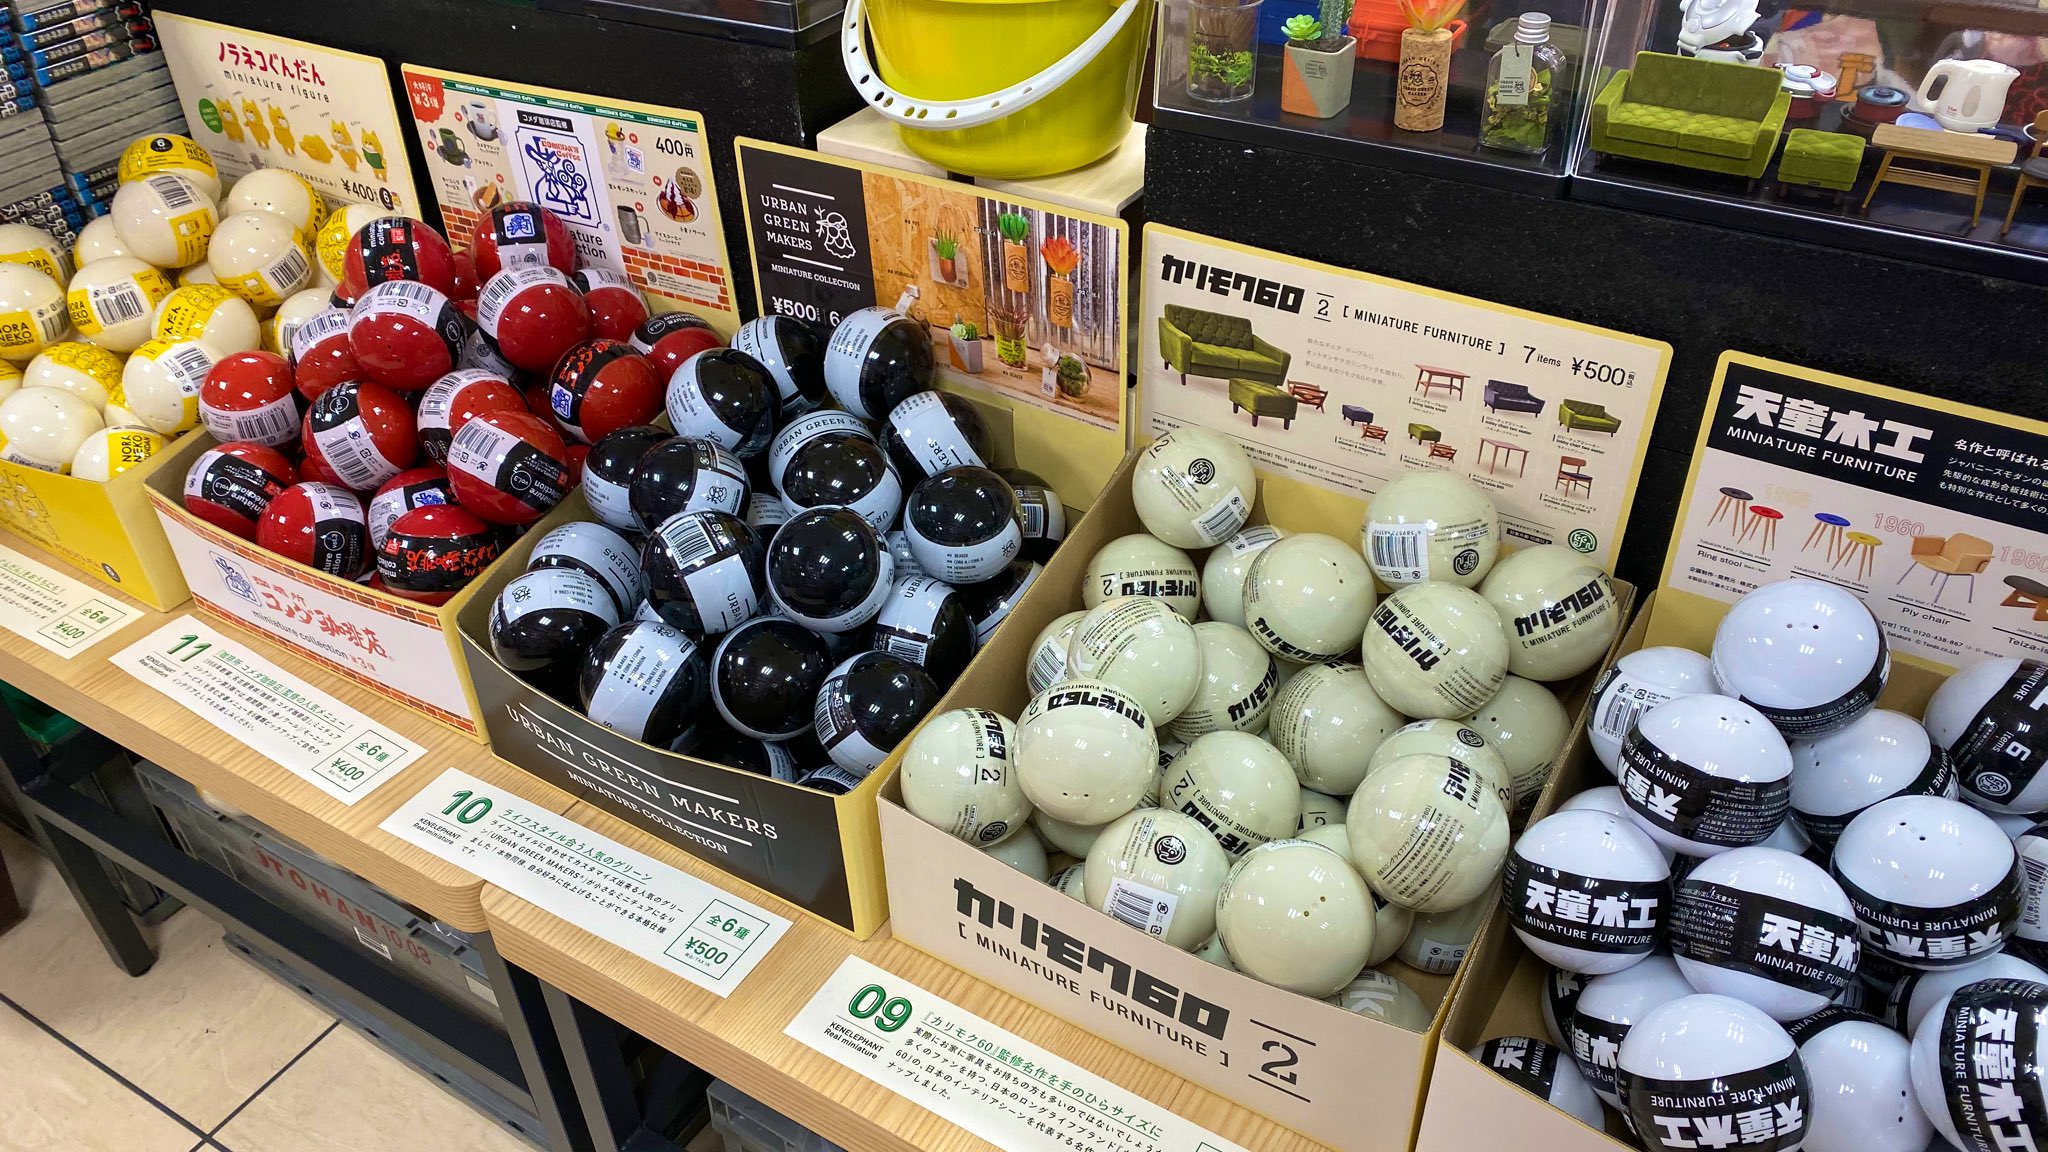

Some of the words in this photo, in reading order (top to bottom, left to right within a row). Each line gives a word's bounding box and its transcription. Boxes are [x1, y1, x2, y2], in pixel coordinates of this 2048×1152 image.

[218, 41, 325, 87] ノラネコぐんだん
[223, 69, 283, 92] miniature
[291, 84, 330, 103] figure
[556, 149, 581, 162] Coffee
[656, 137, 694, 158] 400円
[341, 177, 374, 203] ¥400
[760, 194, 808, 216] URBAN
[763, 213, 810, 234] GREEN
[766, 230, 813, 252] MAKERS
[771, 263, 813, 281] MINIATURE
[814, 273, 861, 292] COLLECTION
[1161, 253, 1306, 314] カリモク60
[1317, 298, 1330, 317] 2
[772, 295, 818, 322] ¥500
[0, 330, 32, 342] NEKO
[1354, 308, 1419, 335] MINIATURE
[1423, 325, 1493, 352] FURNITURE
[1523, 345, 1537, 364] 7
[1537, 353, 1562, 368] items
[1571, 356, 1626, 387] ¥500
[773, 429, 802, 457] URBAN
[804, 418, 846, 432] GREEN
[1732, 384, 1934, 464] 天童木工
[122, 435, 132, 463] NORA
[132, 435, 144, 463] NEKO
[1274, 453, 1284, 462] TEL
[1726, 426, 1818, 459] MINIATURE
[1822, 450, 1918, 483] FURNITURE
[1874, 512, 1925, 538] 1960
[603, 547, 638, 587] MAKERS
[1126, 568, 1163, 579] FURNITURE
[1697, 550, 1718, 562] Ring
[1719, 555, 1742, 568] stool
[80, 607, 110, 625] 全6種
[1514, 579, 1604, 637] カリモク60
[1902, 607, 1919, 618] Ply
[1922, 613, 1950, 626] chair
[55, 620, 86, 640] ¥400
[252, 610, 300, 638] miniature
[299, 631, 349, 660] collection
[1372, 603, 1441, 672] カリモク60
[1529, 625, 1572, 647] MINIATURE
[1572, 603, 1608, 629] FURNITURE
[1899, 624, 1911, 633] TEL
[1913, 628, 1964, 648] 0120-438-867
[166, 633, 212, 663] 11
[138, 659, 149, 668] Real
[147, 664, 169, 678] miniature
[144, 654, 177, 674] KENELEPHANT
[971, 719, 984, 751] FURNITURE
[1992, 730, 2014, 753] items
[356, 741, 391, 763] 全6種
[2006, 741, 2032, 762] 6
[331, 757, 365, 782] ¥400
[504, 703, 574, 756] URBAN
[582, 750, 660, 800] GREEN
[667, 791, 778, 841] MAKERS
[441, 789, 493, 825] 10
[566, 769, 642, 815] MINIATURE
[641, 809, 729, 855] COLLECTION
[1198, 794, 1235, 826] FURNITURE
[412, 821, 427, 834] Real
[425, 828, 455, 846] miniature
[418, 816, 462, 841] KENELEPHANT
[461, 844, 477, 858] です。
[502, 807, 653, 882] ライフスタイル合う人気のグリーン
[517, 844, 546, 863] GREEN
[489, 818, 685, 914] ライフスタイルに合わせてカスタマイズ出来る人気のグリー
[1525, 877, 1658, 930] 天童木工
[1850, 898, 1920, 930] FURNITURE
[1925, 905, 1998, 931] MINIATURE
[706, 913, 751, 941] 全6種
[1525, 915, 1588, 942] MINIATURE
[1592, 931, 1652, 946] FURNITURE
[684, 935, 729, 966] ¥500
[953, 876, 1230, 1041] カリモク60
[1754, 951, 1825, 982] MINIATURE
[848, 983, 914, 1033] 09
[975, 935, 1082, 997] MINIATURE
[1089, 994, 1208, 1058] FURNITURE
[1261, 1038, 1299, 1089] 2
[823, 1027, 841, 1042] Real
[840, 1035, 878, 1060] miniature
[829, 1021, 885, 1053] KENELEPHANT
[1954, 1006, 1972, 1079] MINIATURE
[886, 1060, 951, 1101] ナップしました。
[923, 1009, 1164, 1139] 『カリモク60』監修名作を手のひらサイズに
[1974, 1001, 2039, 1152] 天童木工
[1651, 1094, 1726, 1109] FURNITURE
[1730, 1075, 1796, 1105] MINIATURE
[1653, 1095, 1803, 1150] 天童木工
